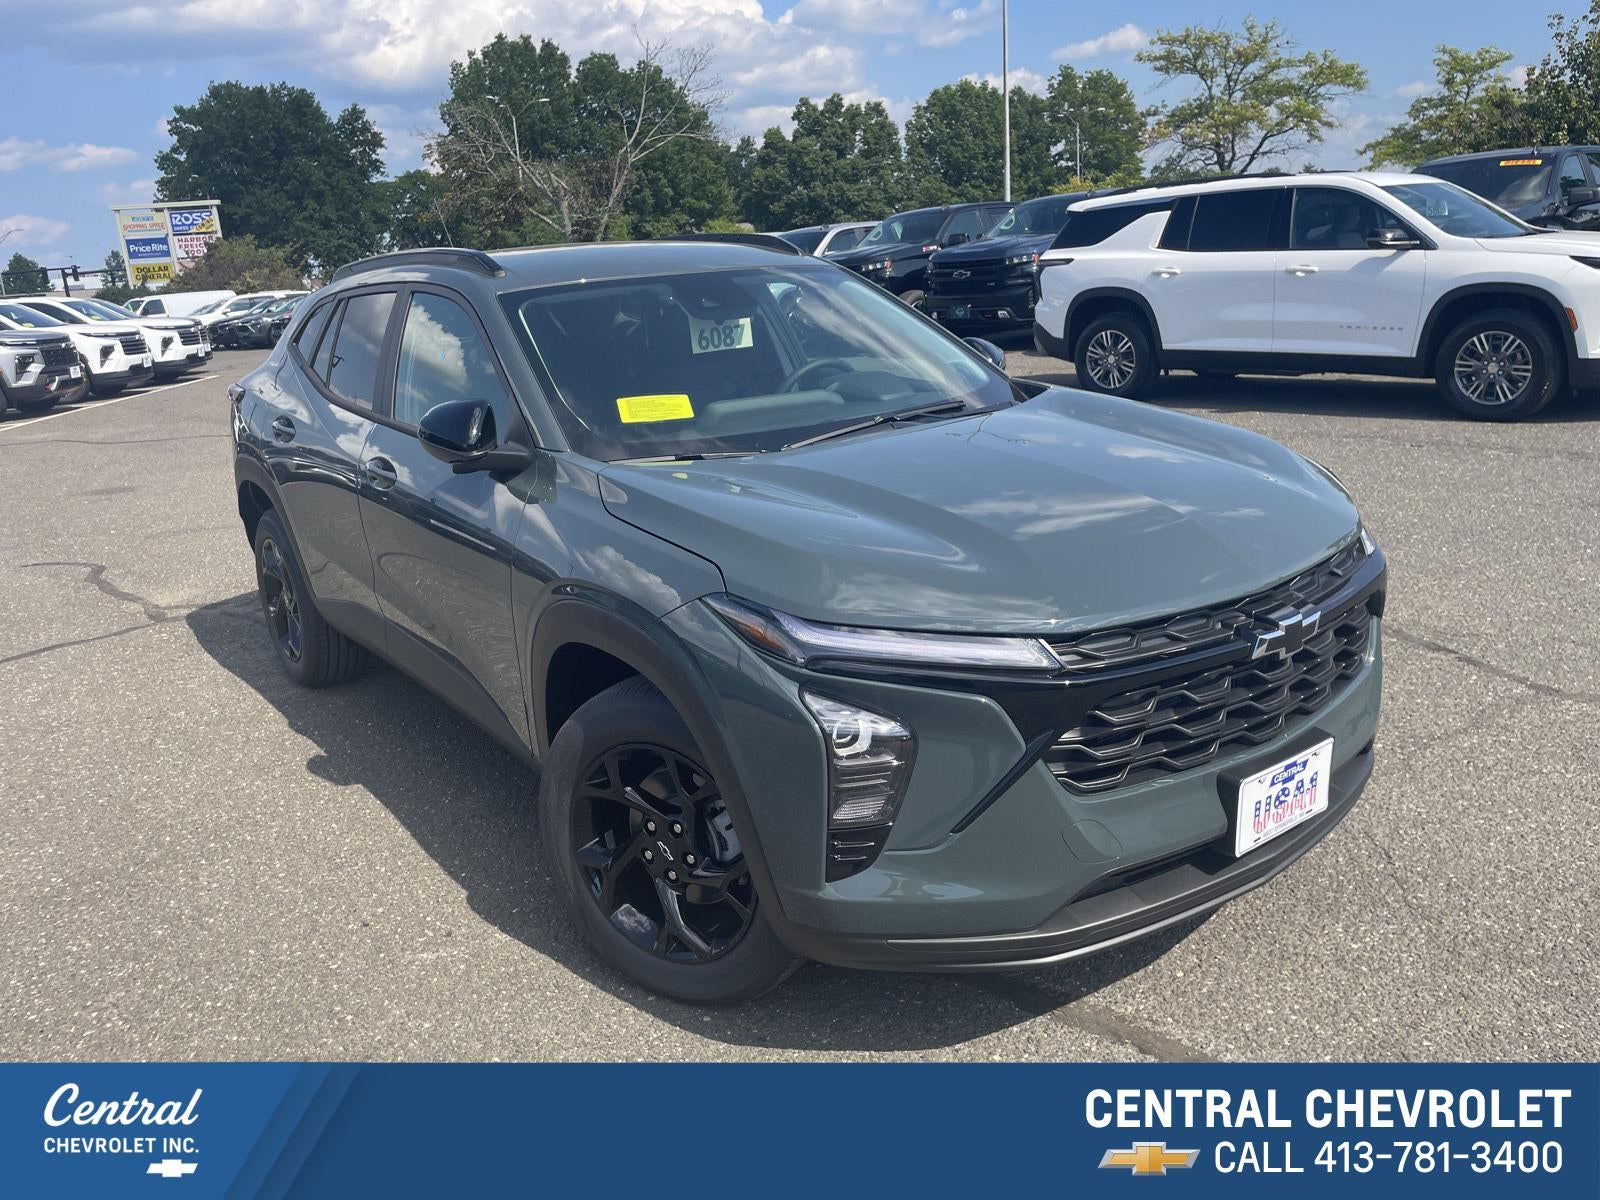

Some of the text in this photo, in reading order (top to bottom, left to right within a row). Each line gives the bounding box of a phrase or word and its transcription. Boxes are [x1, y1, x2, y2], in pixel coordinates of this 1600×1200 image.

[171, 212, 211, 225] ROSS
[177, 235, 214, 244] HARBOR
[179, 242, 205, 250] FREIG
[136, 265, 169, 274] DOLLAR
[697, 323, 746, 351] 6087
[1273, 763, 1305, 783] CENTRAL
